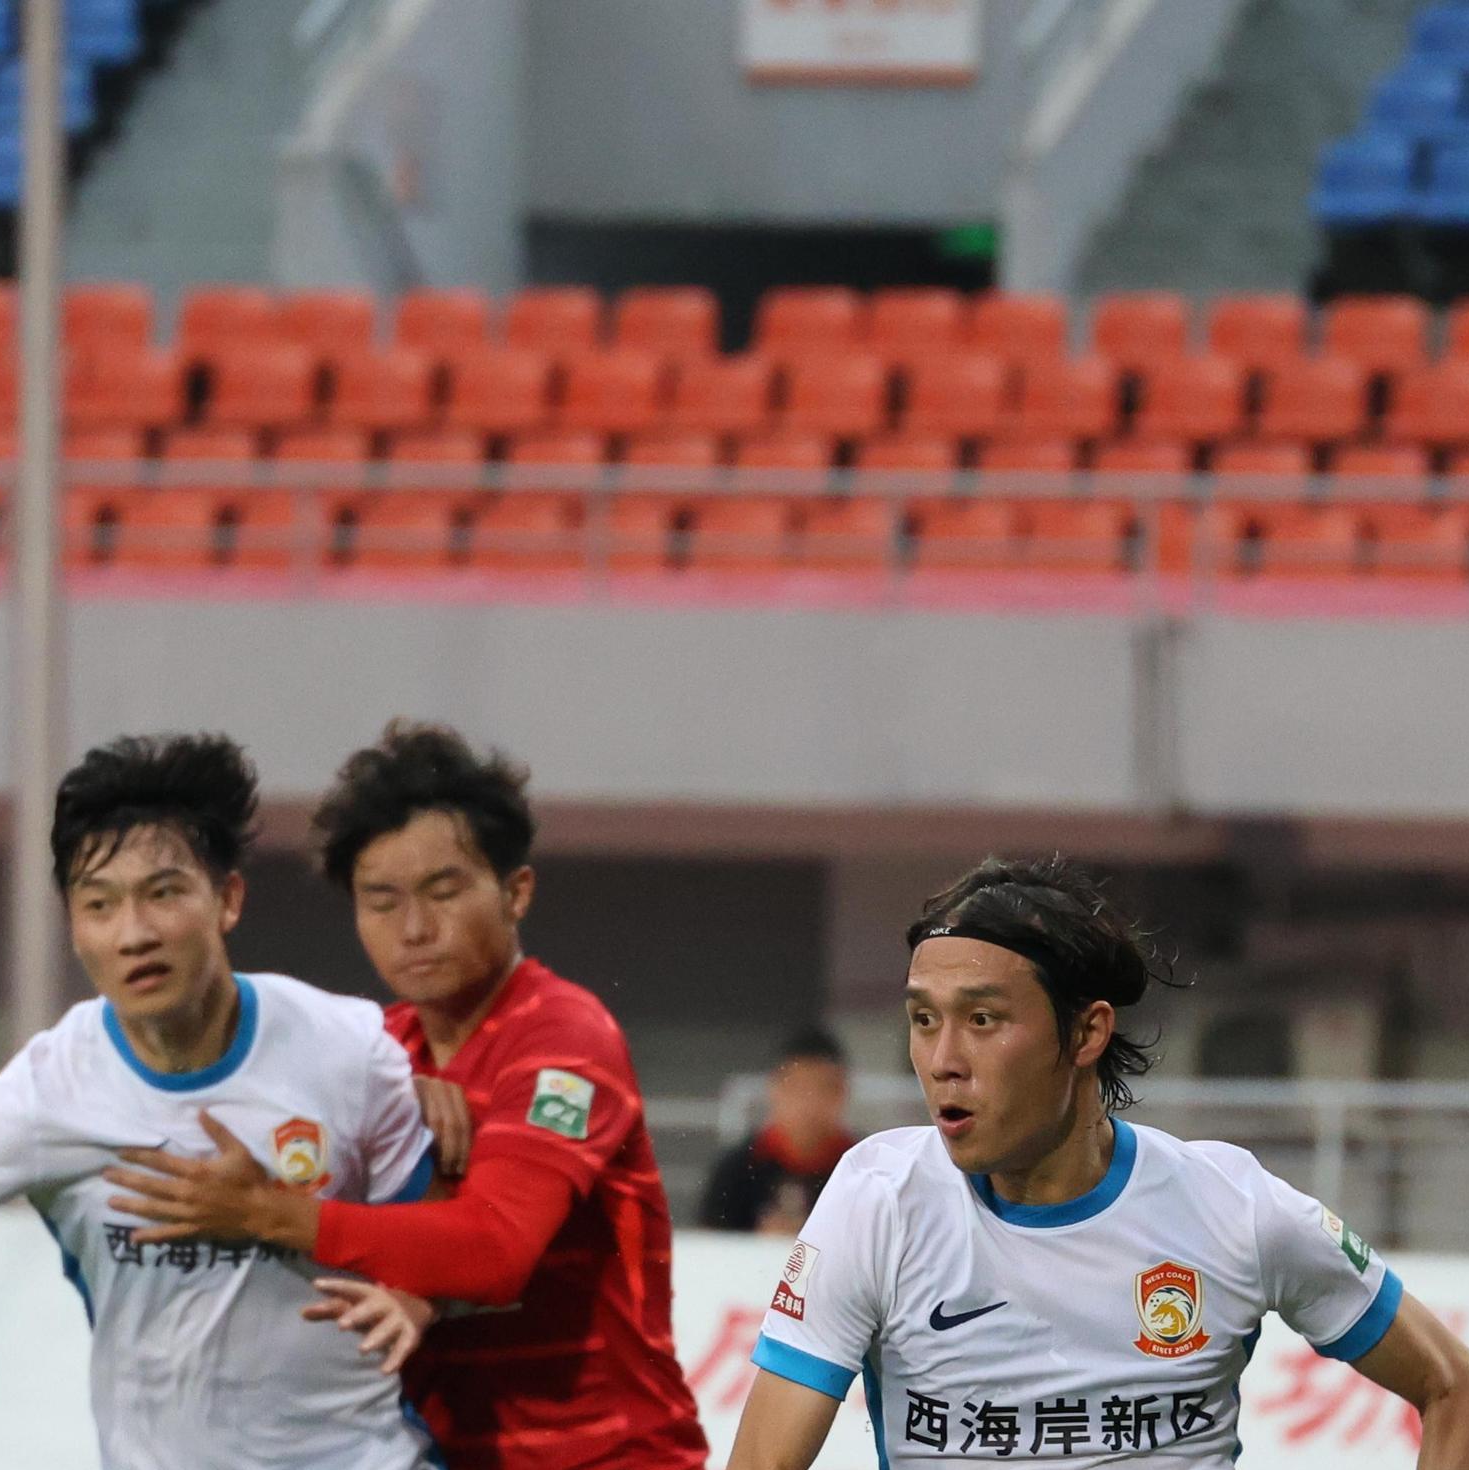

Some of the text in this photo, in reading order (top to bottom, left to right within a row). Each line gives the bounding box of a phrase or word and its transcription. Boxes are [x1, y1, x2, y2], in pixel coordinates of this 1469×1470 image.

[930, 927, 951, 936] NIKE
[1144, 1271, 1192, 1286] WEST COAST
[905, 1388, 1216, 1456] 西海岸新区
